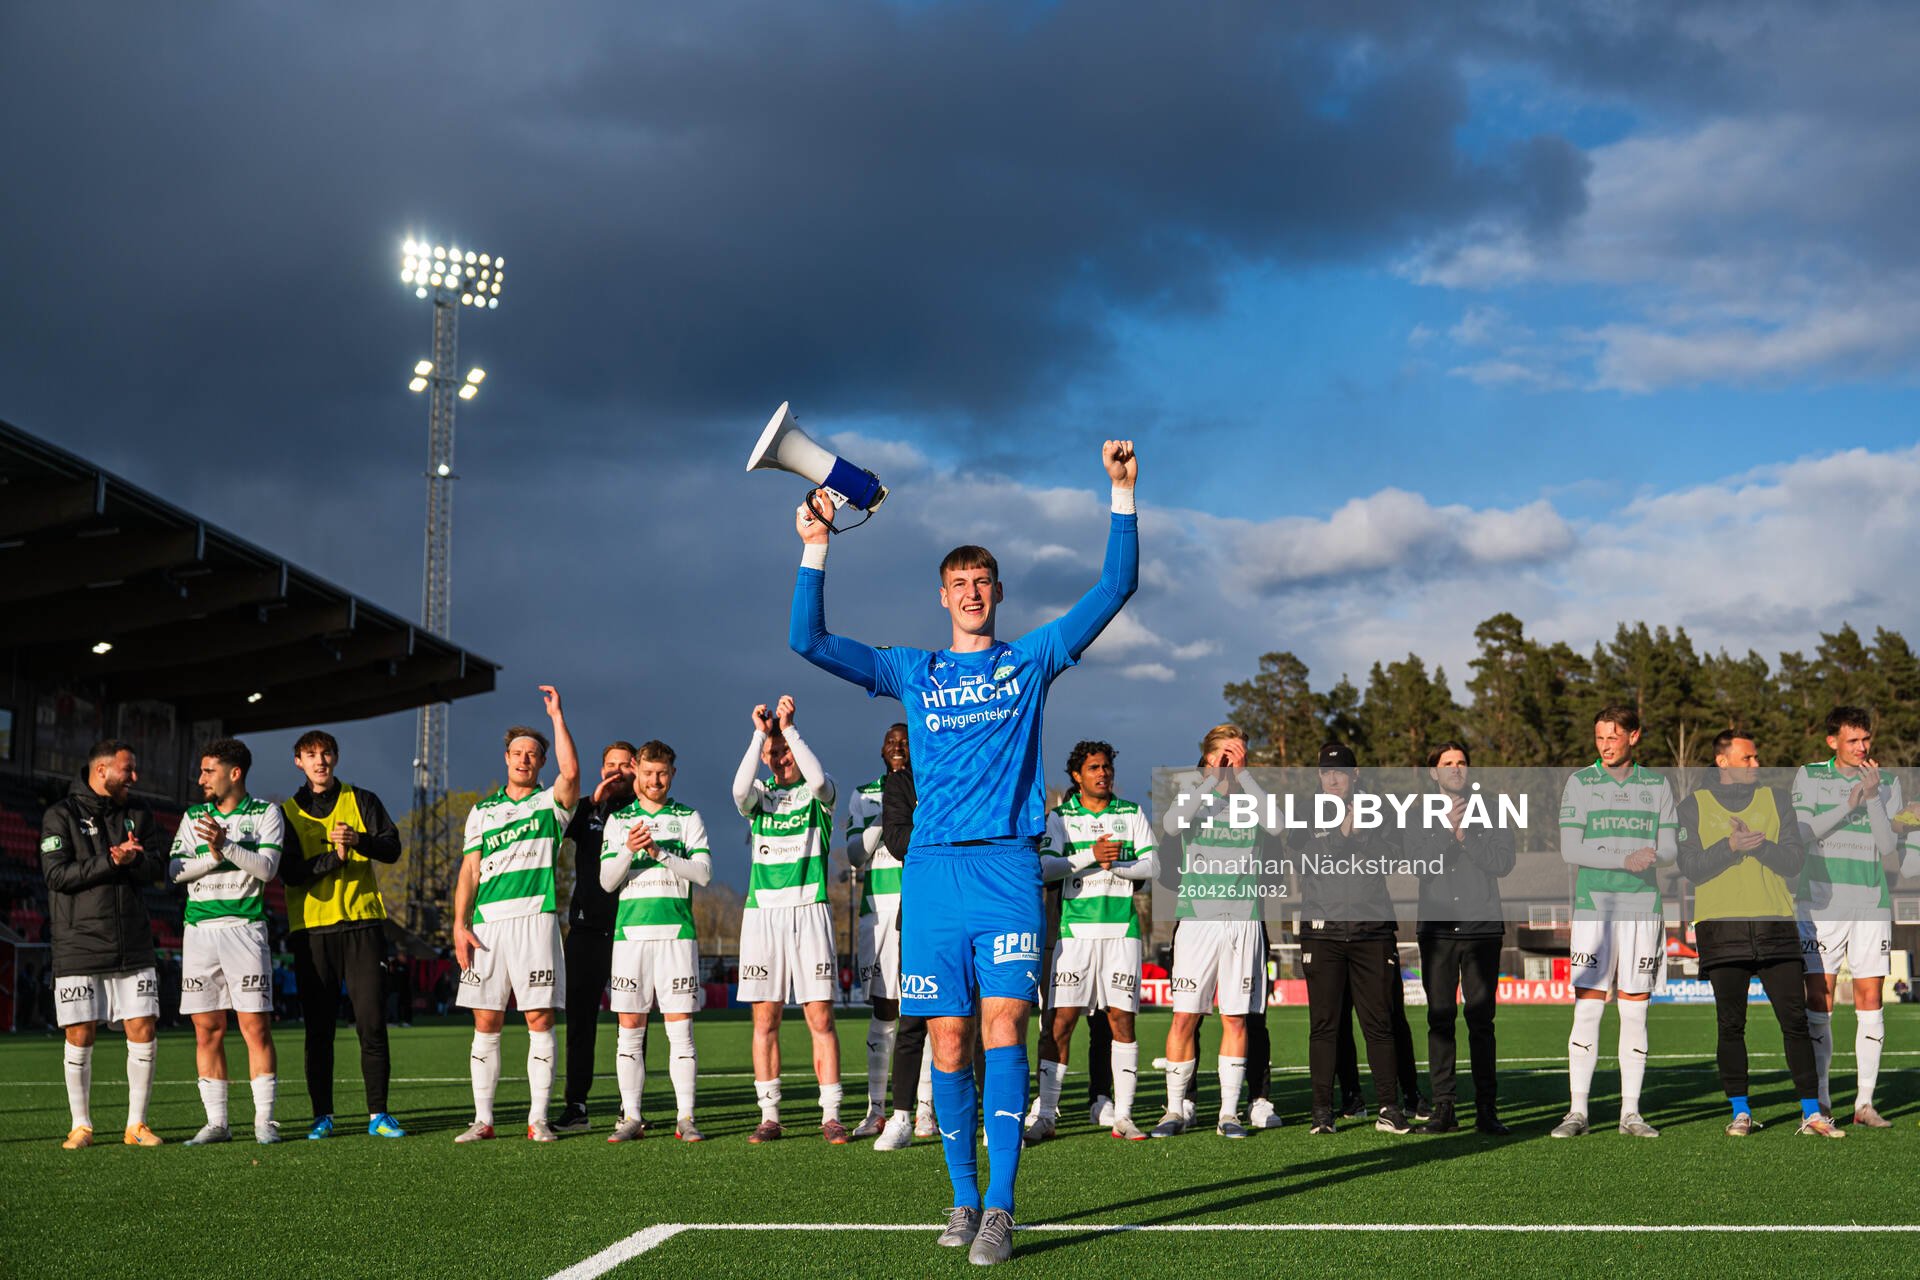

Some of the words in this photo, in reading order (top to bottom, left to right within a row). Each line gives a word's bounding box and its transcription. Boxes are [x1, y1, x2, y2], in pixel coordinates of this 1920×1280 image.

[922, 678, 1020, 708] HITACHI
[942, 707, 1019, 729] Hygienteknk
[1592, 817, 1653, 831] HITACHI
[994, 932, 1040, 957] SPOL
